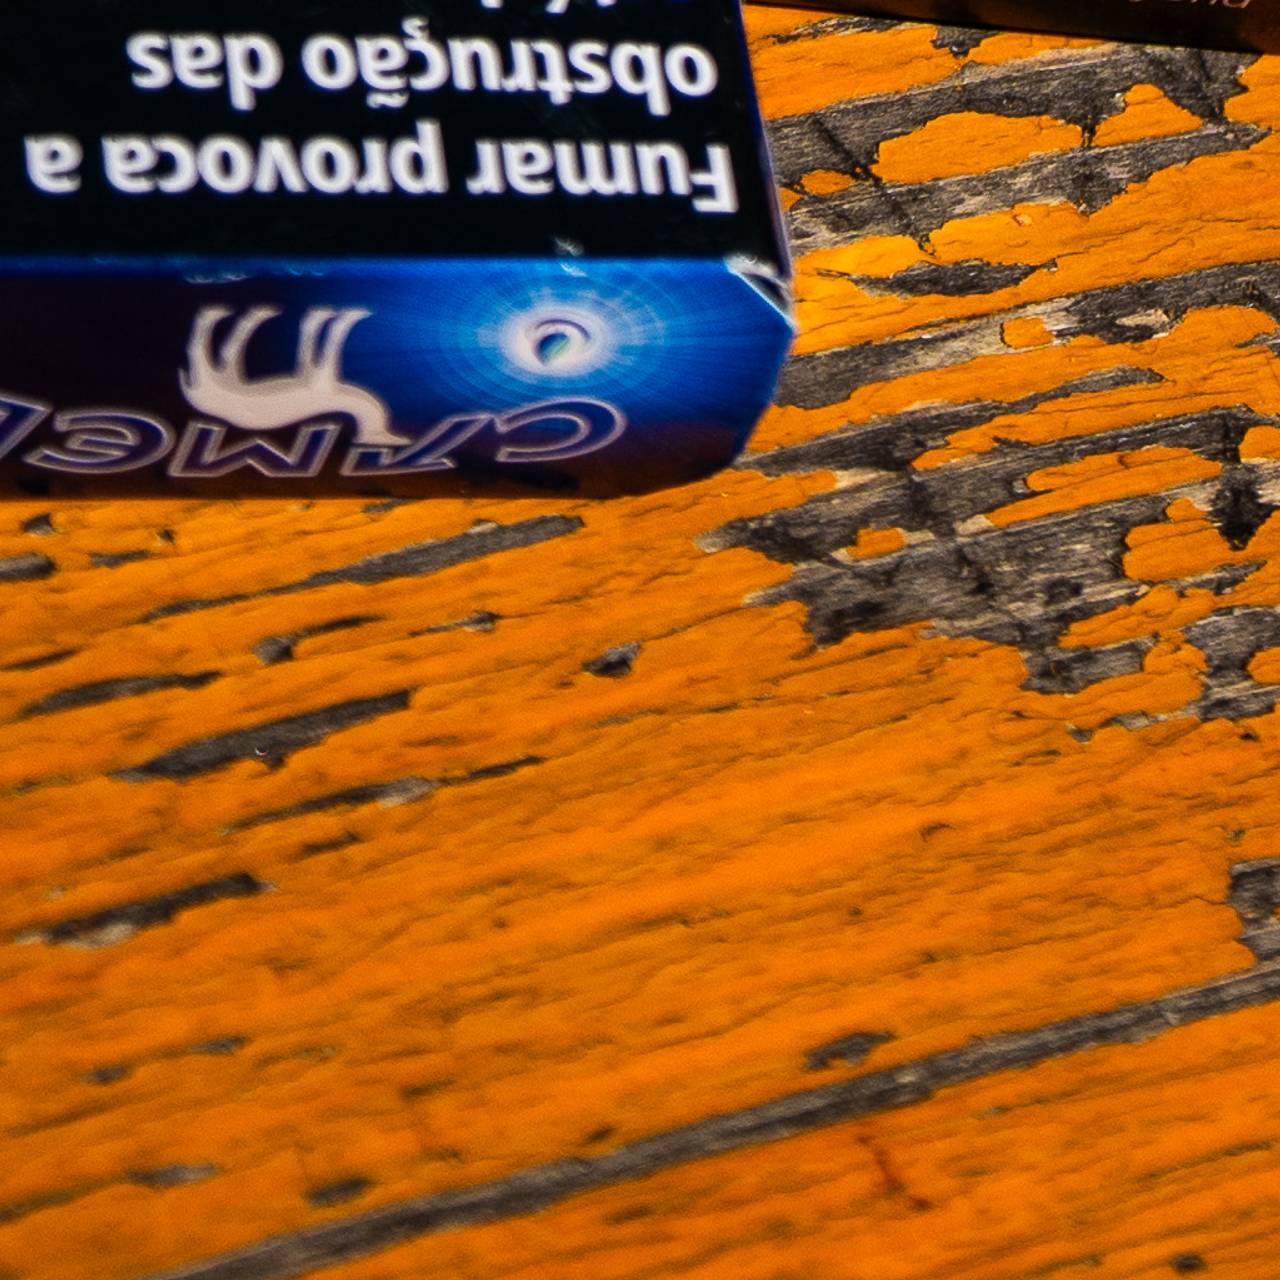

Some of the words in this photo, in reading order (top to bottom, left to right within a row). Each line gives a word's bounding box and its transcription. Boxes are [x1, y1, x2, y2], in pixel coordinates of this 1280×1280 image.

[125, 32, 282, 111] das
[301, 17, 717, 116] obstrução
[23, 135, 81, 193] a
[101, 119, 447, 194] provoca
[465, 139, 737, 213] Fumar
